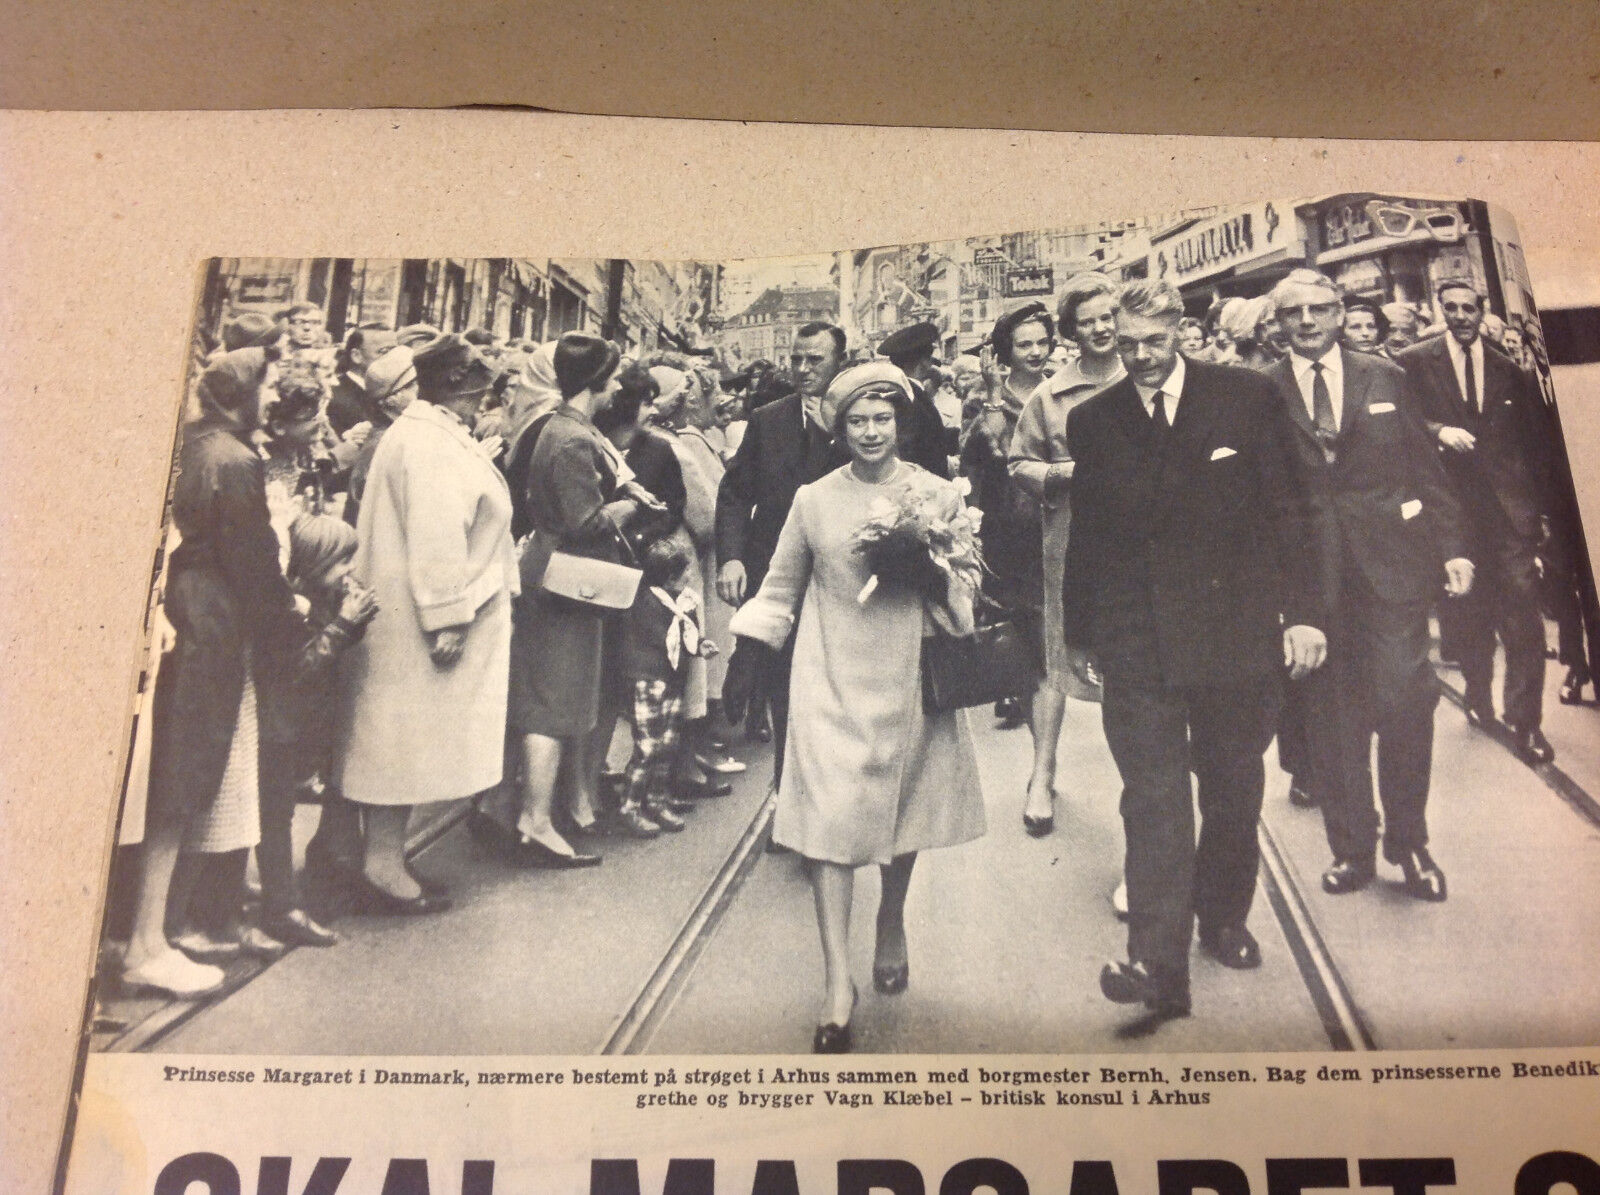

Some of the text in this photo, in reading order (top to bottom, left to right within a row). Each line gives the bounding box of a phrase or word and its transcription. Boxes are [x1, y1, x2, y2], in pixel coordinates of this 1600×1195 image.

[162, 1066, 255, 1083] Prinsesse
[262, 1068, 353, 1087] Margaret
[359, 1069, 367, 1084] i
[374, 1070, 470, 1087] Danmark,
[477, 1072, 565, 1085] nærmere
[571, 1069, 649, 1085] bestemt
[653, 1067, 678, 1089] på
[685, 1069, 752, 1089] strøget
[758, 1069, 765, 1084] i
[837, 1071, 918, 1084] sammen
[928, 1068, 970, 1084] med
[978, 1067, 1091, 1089] borgmester
[1181, 1066, 1257, 1083] Jensen.
[1266, 1066, 1307, 1084] Bag
[1317, 1065, 1363, 1082] dem
[1370, 1064, 1502, 1083] prinsesserne
[636, 1090, 698, 1110] grethe
[707, 1093, 729, 1109] og
[738, 1090, 815, 1109] brygger
[824, 1090, 874, 1109] Vagn
[883, 1089, 954, 1107] Klæbel
[980, 1089, 1046, 1106] britisk
[1056, 1088, 1124, 1106] konsul
[1132, 1090, 1141, 1105] i
[1147, 1088, 1211, 1105] Århus
